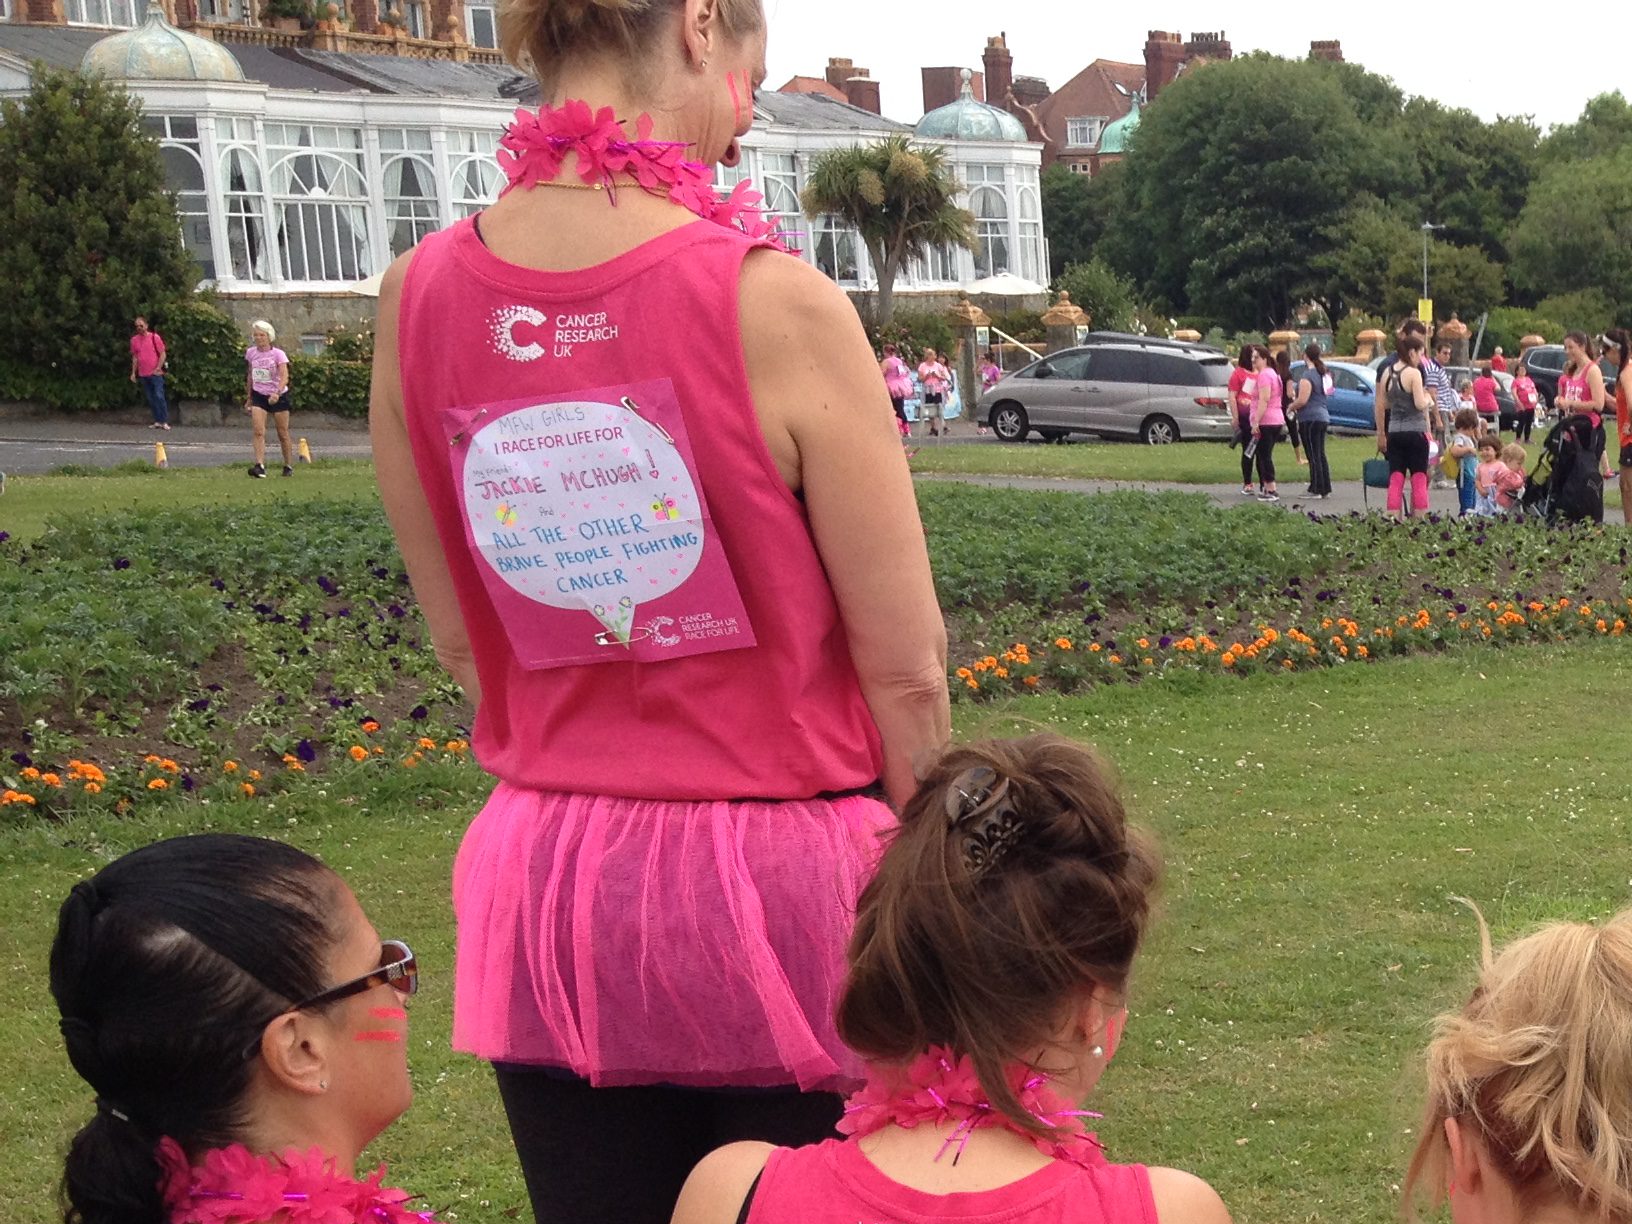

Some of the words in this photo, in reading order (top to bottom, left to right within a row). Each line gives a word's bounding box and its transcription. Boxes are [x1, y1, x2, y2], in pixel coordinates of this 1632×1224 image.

[556, 312, 607, 328] CANCER
[555, 325, 618, 343] RESEARCH
[553, 344, 573, 357] UK
[542, 407, 585, 426] GIRLS
[494, 443, 499, 455] I
[502, 438, 536, 454] RACE
[538, 435, 565, 449] FOR
[565, 431, 593, 445] LIFE
[595, 426, 624, 442] FOR
[475, 476, 546, 500] JACKIE
[492, 532, 526, 550] ALL
[529, 526, 567, 545] THE
[578, 513, 650, 540] OTHER
[496, 554, 548, 573] BRAVE
[554, 545, 613, 569] PEOPLE
[622, 532, 698, 560] FIGHTING
[557, 568, 629, 593] CANCER
[679, 613, 712, 624] CANCER
[682, 620, 724, 632] RESEARCH
[726, 617, 738, 626] UK
[685, 629, 706, 640] RACE
[707, 628, 723, 637] FOR
[724, 625, 740, 635] LIFE
